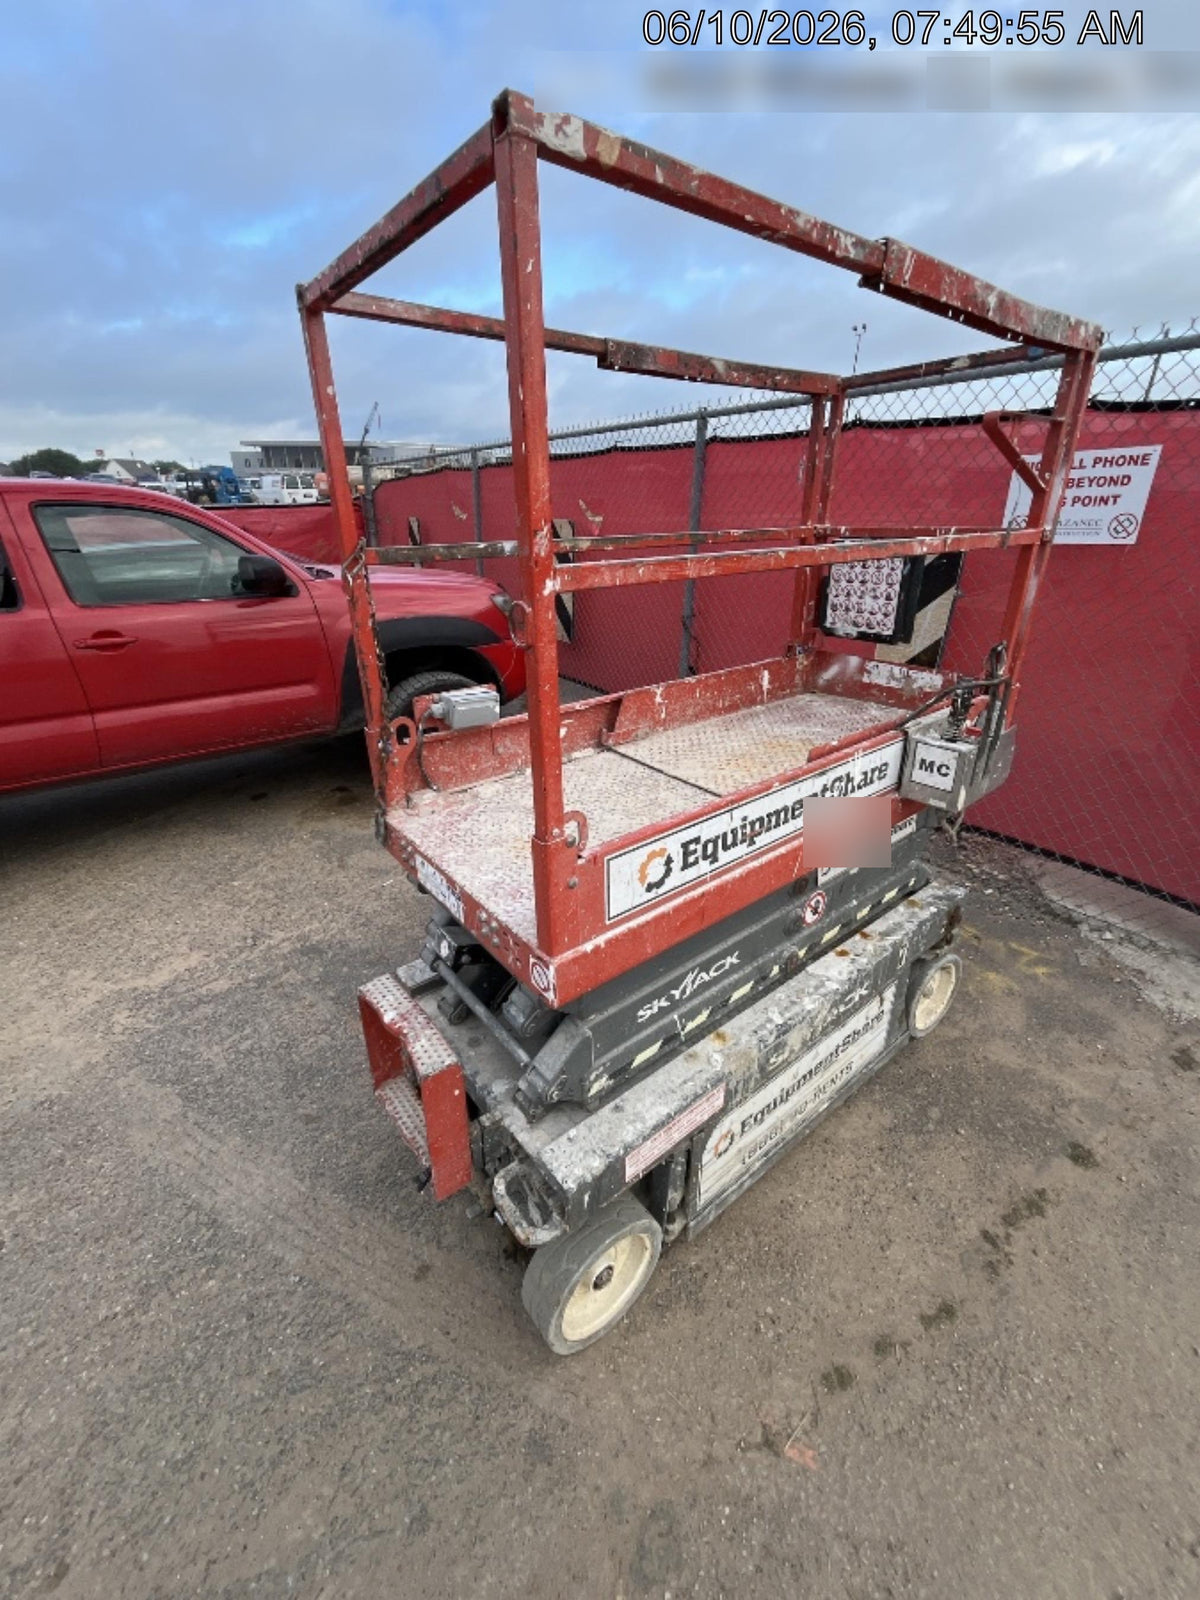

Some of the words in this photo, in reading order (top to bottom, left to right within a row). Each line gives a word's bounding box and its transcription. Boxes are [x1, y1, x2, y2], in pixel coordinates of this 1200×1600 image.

[1092, 453, 1152, 469] PHONE
[1065, 474, 1132, 489] BEYOND
[1071, 494, 1121, 508] POINT
[918, 757, 951, 778] MC
[637, 951, 740, 1023] SKYJACK
